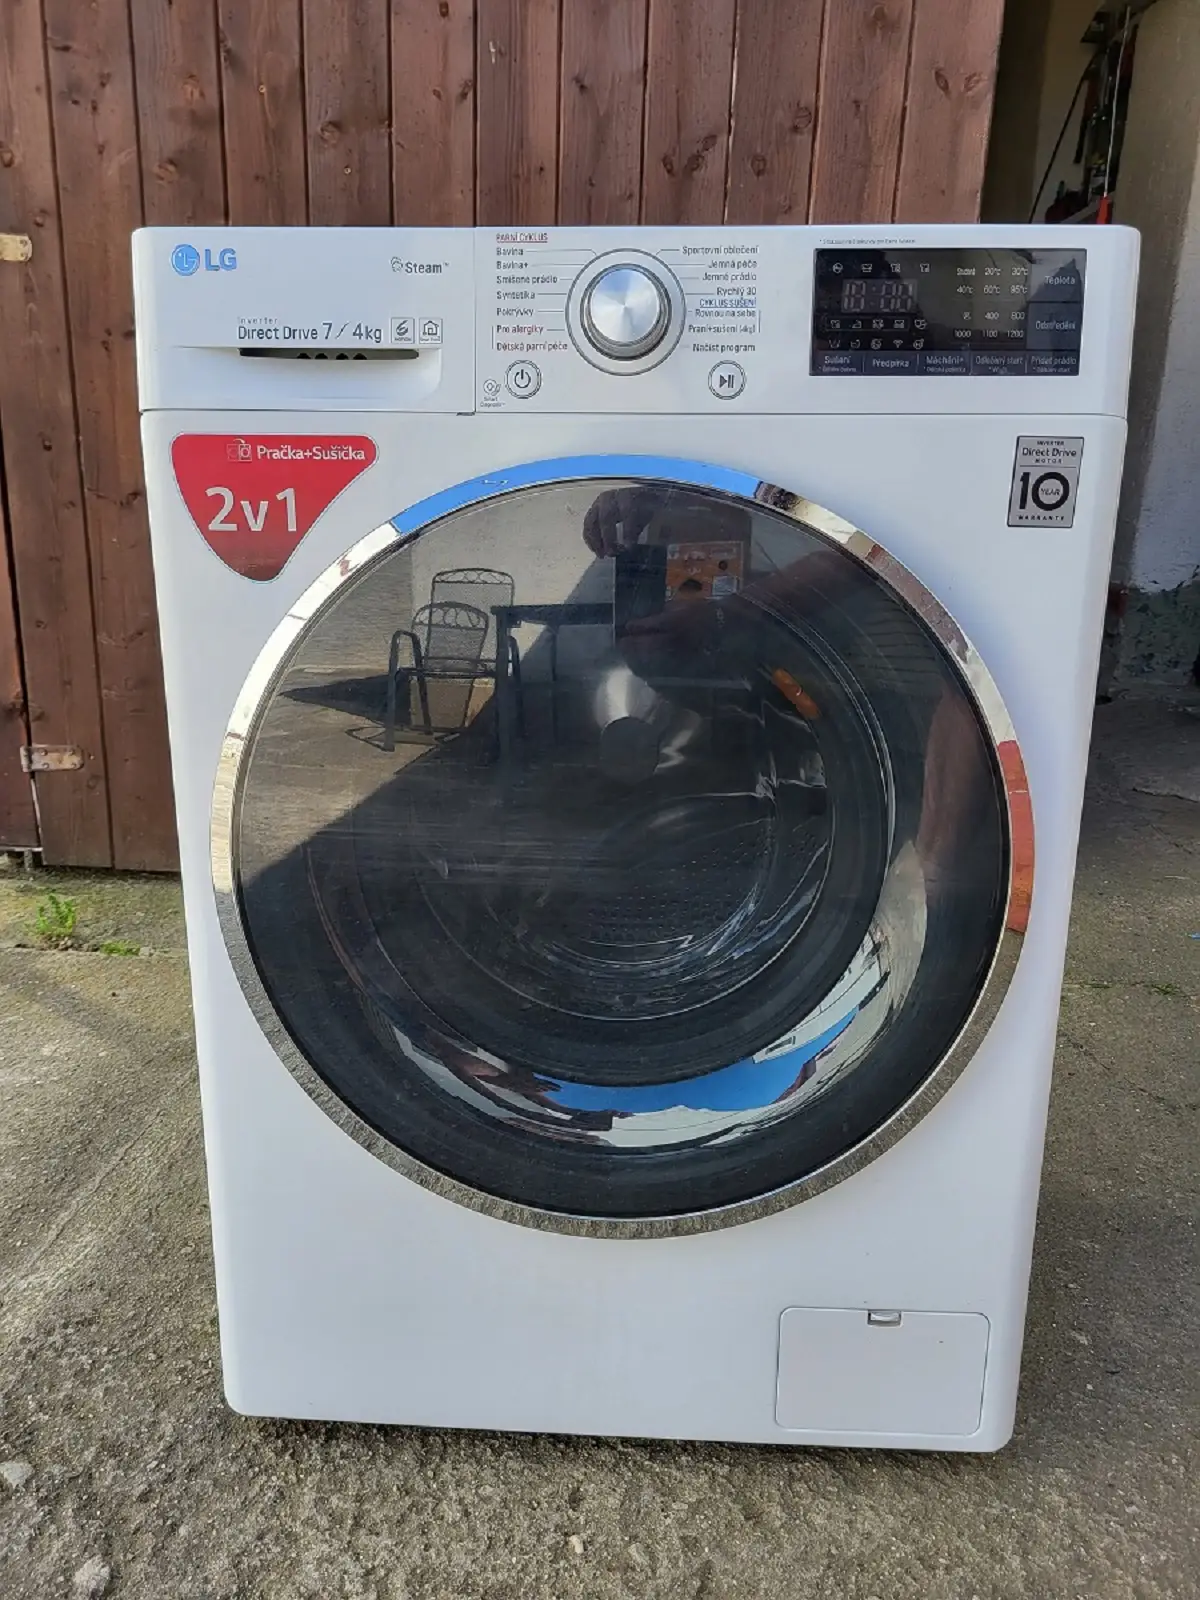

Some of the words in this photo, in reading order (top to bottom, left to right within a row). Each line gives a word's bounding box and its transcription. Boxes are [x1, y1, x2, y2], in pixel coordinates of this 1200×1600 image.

[204, 248, 237, 272] LG
[238, 326, 279, 340] Direct
[283, 326, 318, 340] Drive
[720, 344, 756, 354] program
[256, 445, 366, 460] Pračka+Sušička
[1022, 447, 1050, 457] Direct
[1051, 447, 1077, 457] Drive
